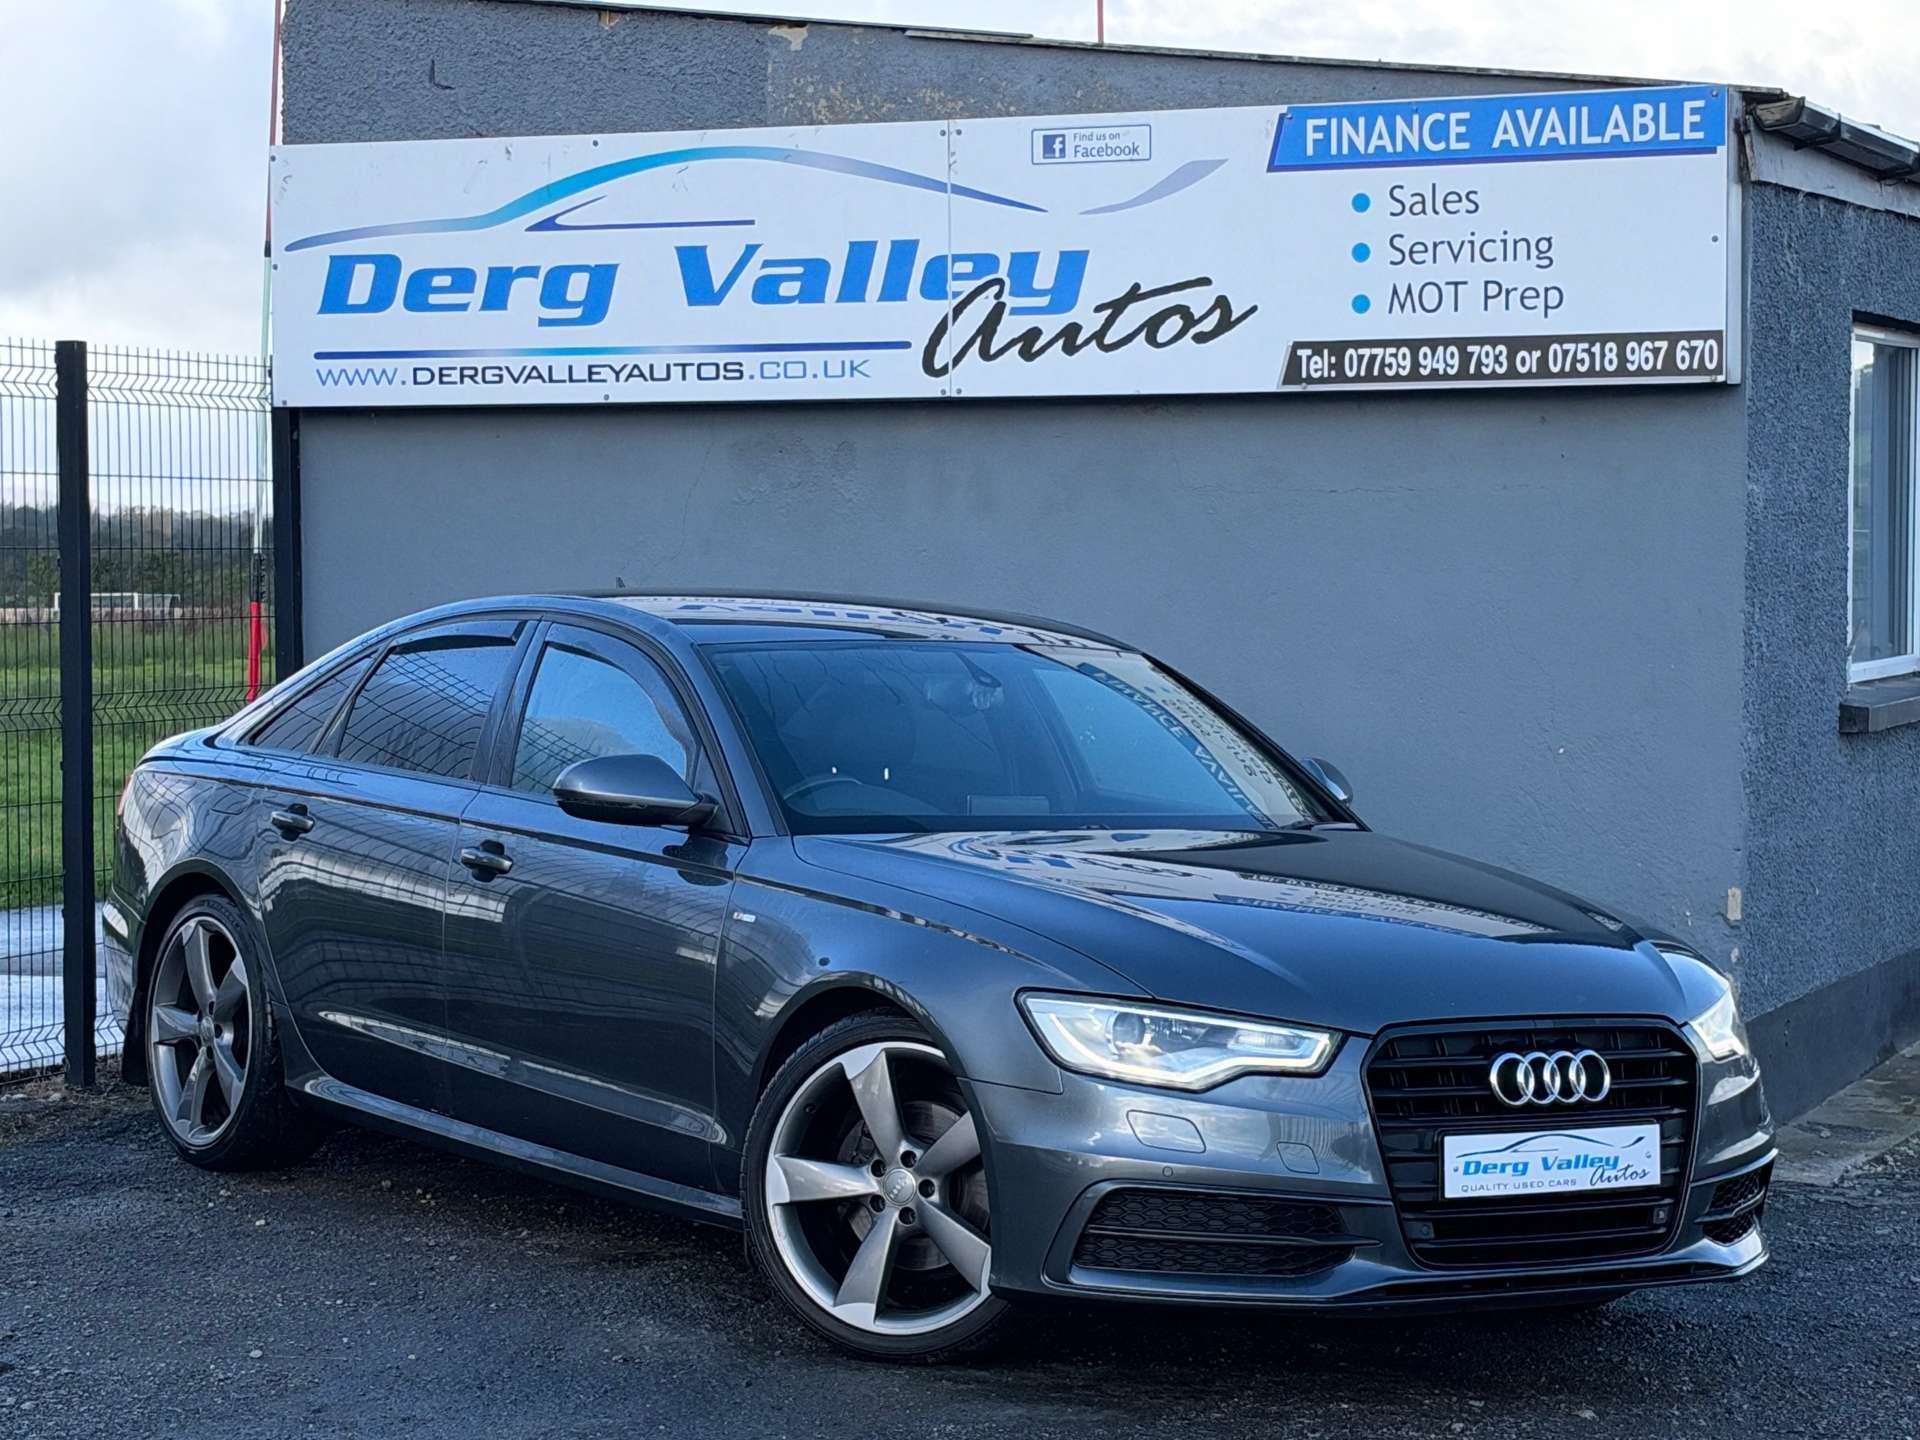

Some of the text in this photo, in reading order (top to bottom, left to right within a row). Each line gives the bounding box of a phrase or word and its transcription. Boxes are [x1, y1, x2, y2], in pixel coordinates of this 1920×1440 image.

[1073, 131, 1121, 142] Find us on
[1306, 100, 1706, 157] FINANCE AVAILABLE
[1073, 142, 1140, 158] Facebook
[1388, 183, 1480, 217] Sales
[1388, 230, 1554, 269] Servicing
[317, 238, 1090, 327] Derg Valley
[1387, 280, 1564, 318] MOT Prep
[922, 276, 1258, 378] Autos
[315, 358, 871, 387] WWW.DERGVALLEYAUTOS.CO.UK
[1297, 338, 1719, 378] Tel: 07759 949 793 or 07518 967 670
[1462, 1153, 1620, 1177] Derg Valley
[1589, 1164, 1651, 1187] Autos
[1461, 1178, 1577, 1193] QUALITY USED CARS
